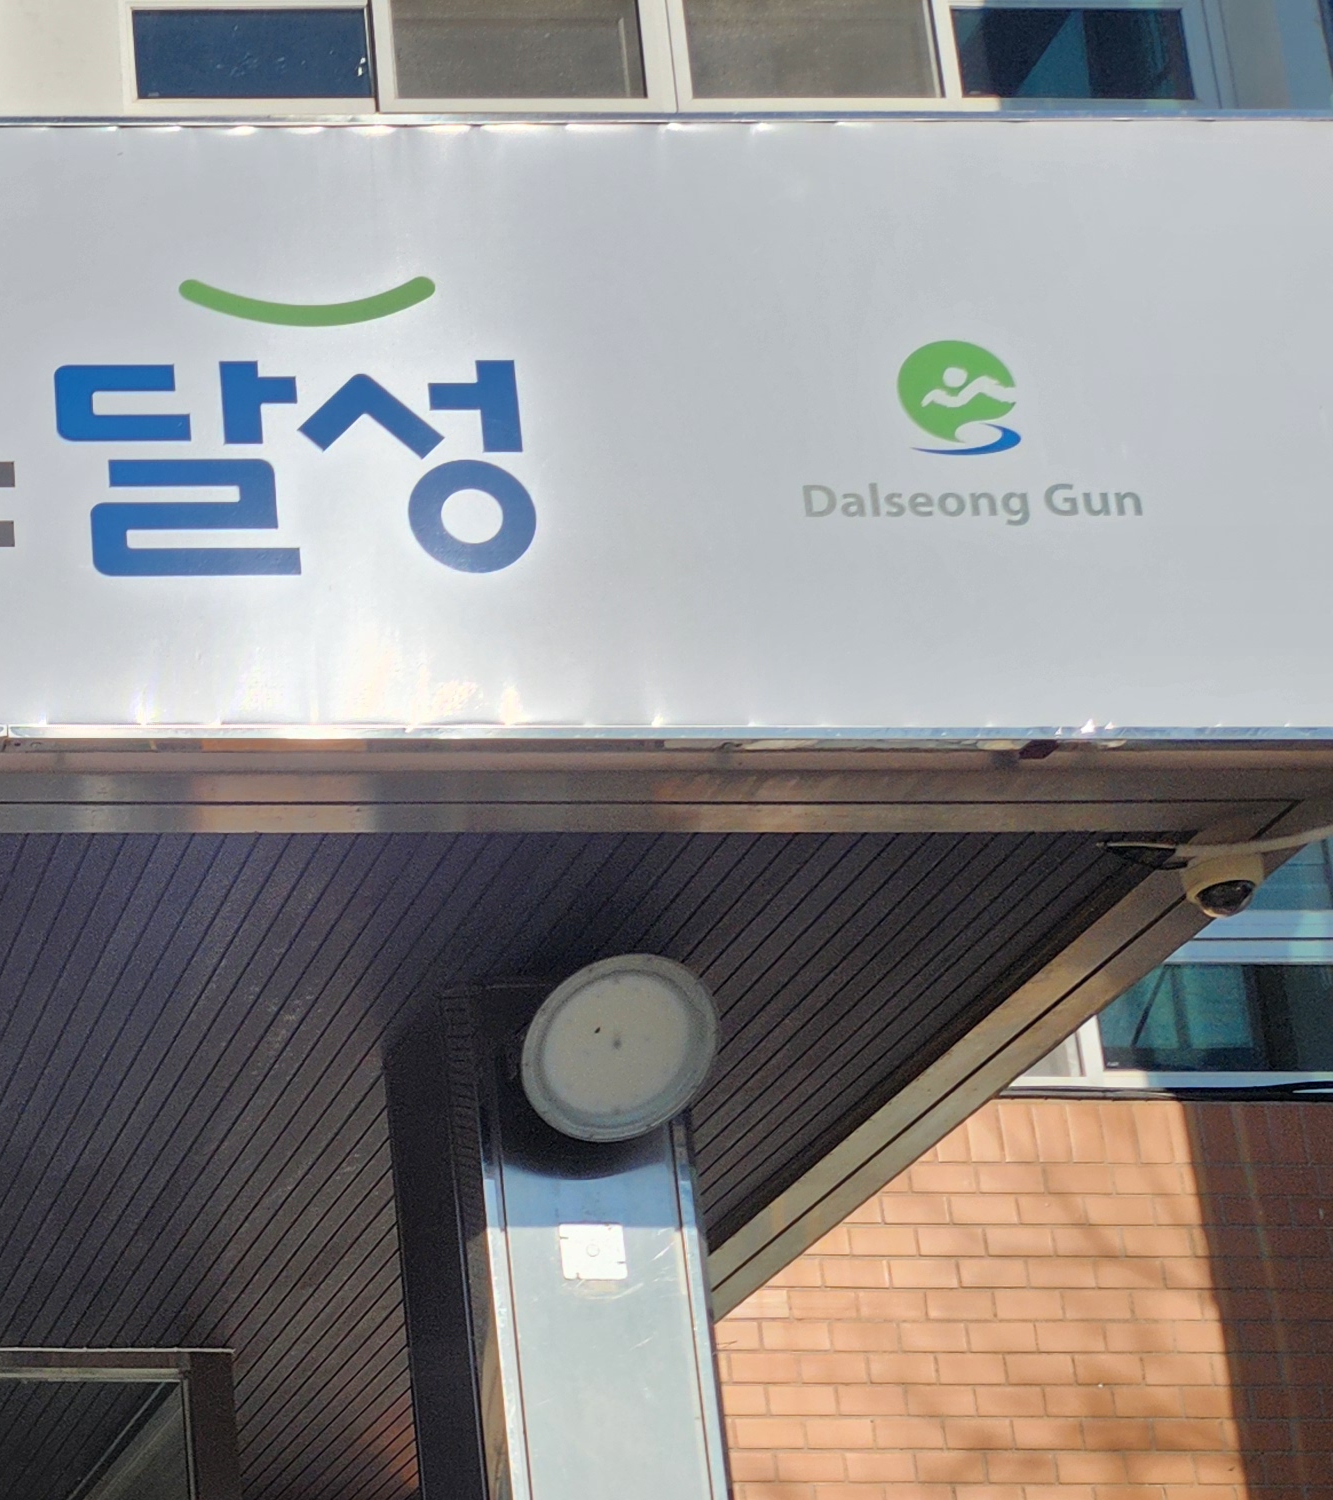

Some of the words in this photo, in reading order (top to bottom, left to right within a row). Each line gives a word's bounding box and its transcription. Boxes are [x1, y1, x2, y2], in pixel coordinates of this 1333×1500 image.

[53, 359, 538, 578] 달성
[800, 482, 1031, 527] Dalseong
[1043, 482, 1145, 518] Gun
